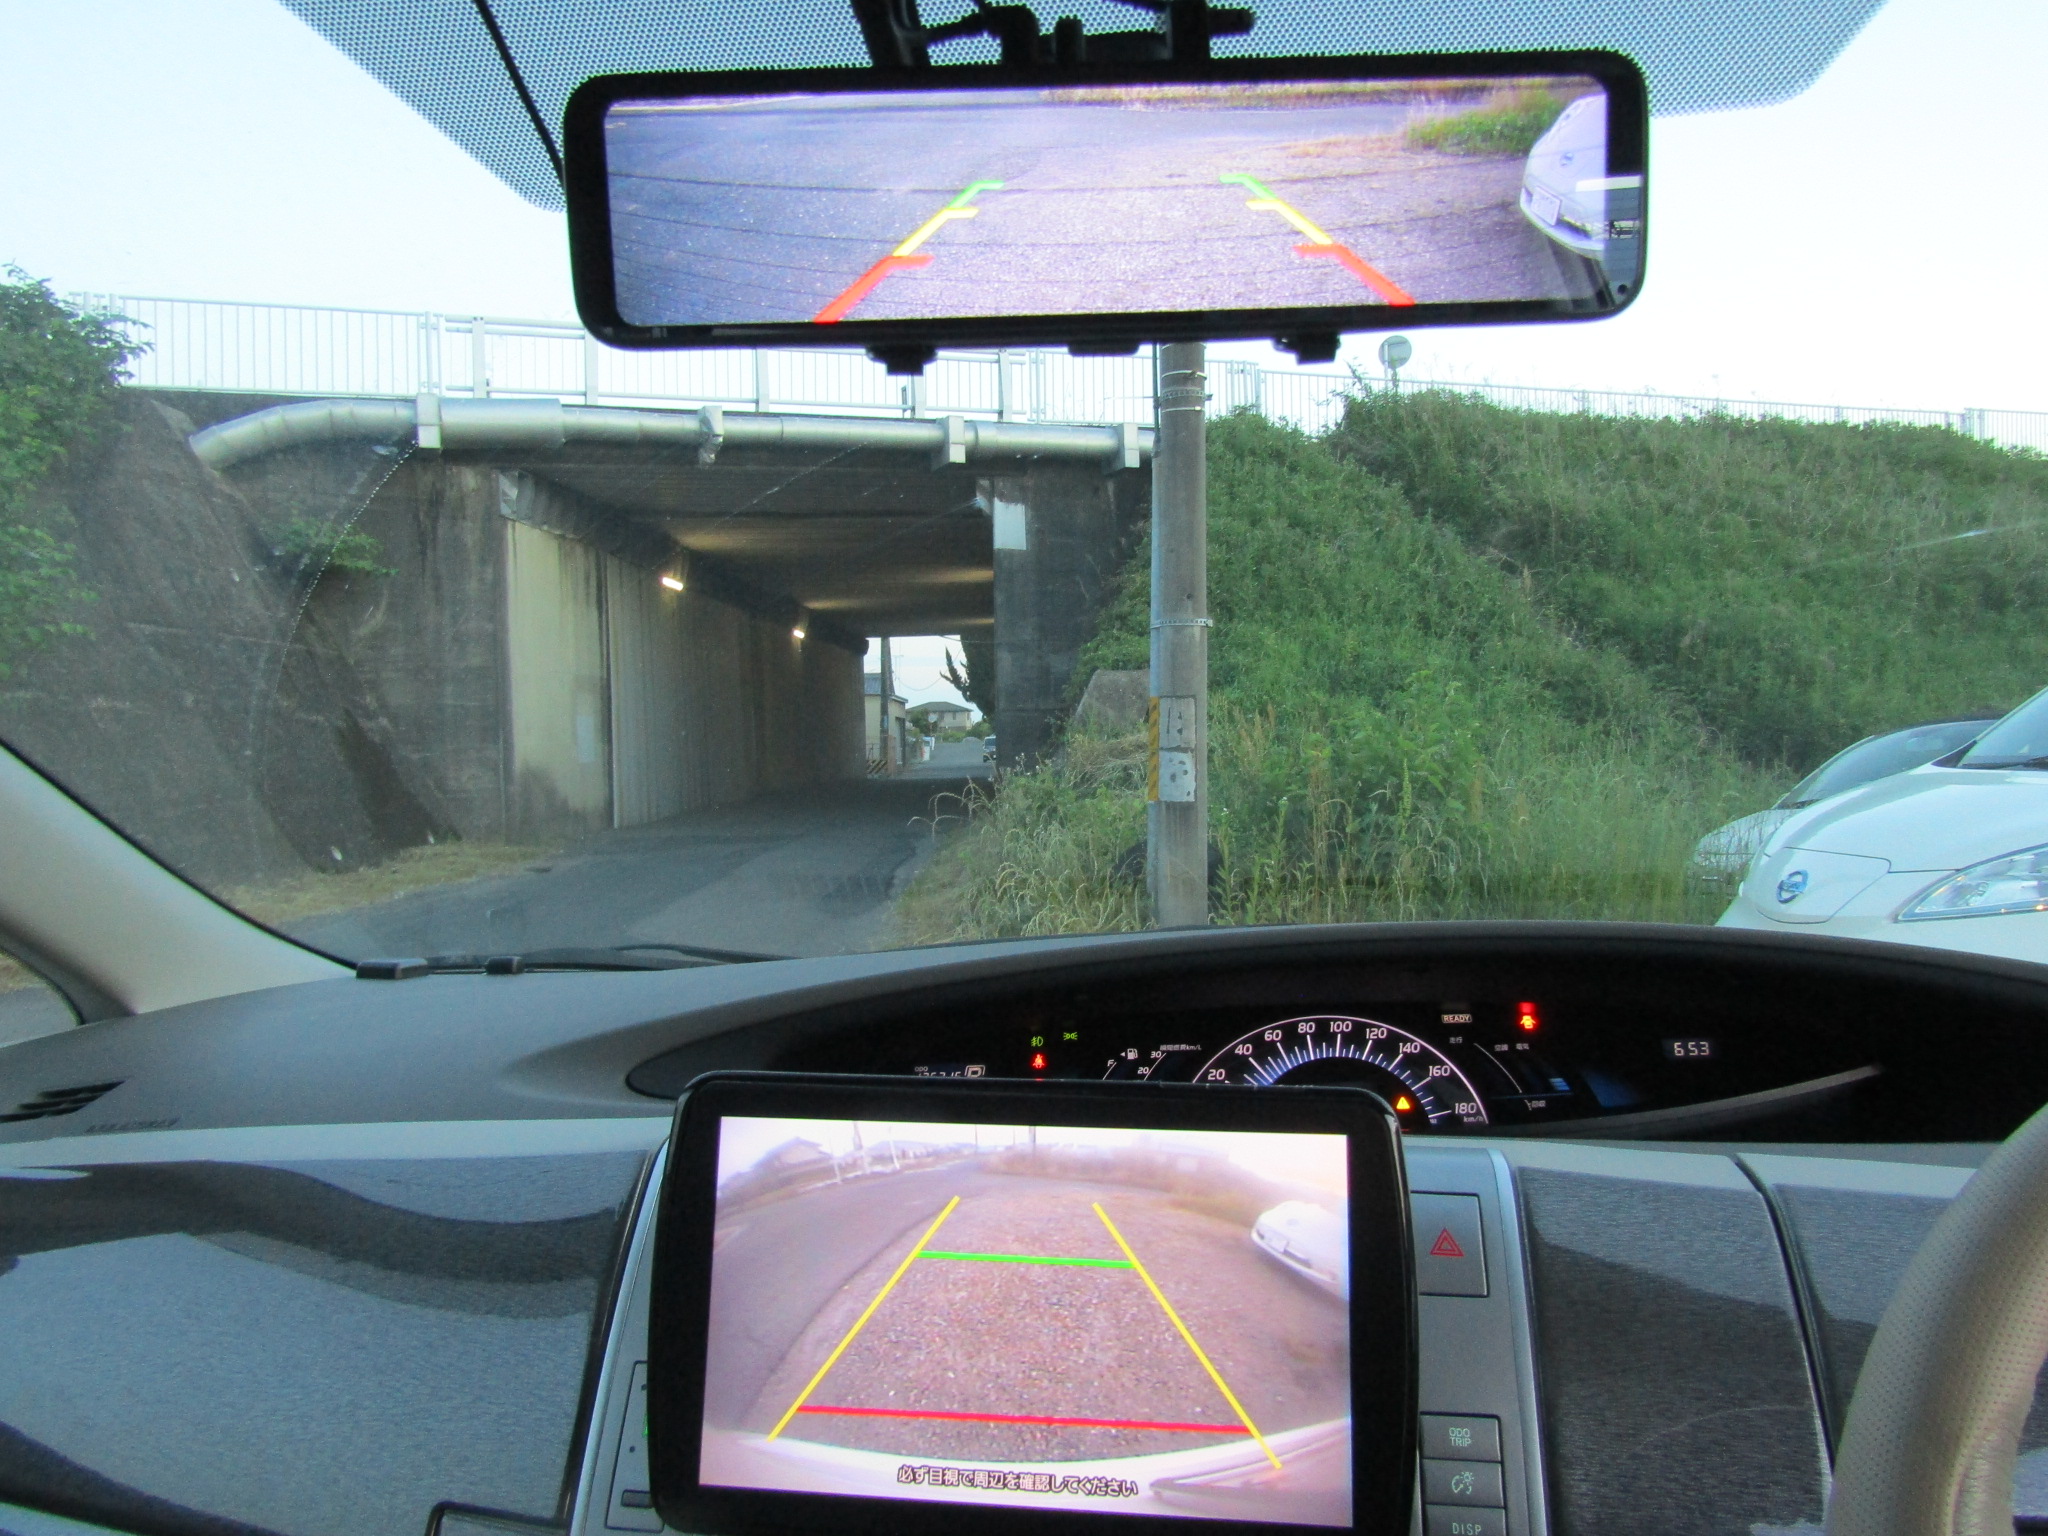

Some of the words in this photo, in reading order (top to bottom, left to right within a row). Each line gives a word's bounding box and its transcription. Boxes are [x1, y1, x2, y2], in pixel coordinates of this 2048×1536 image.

[1442, 1014, 1472, 1024] READY
[1297, 1022, 1316, 1034] 80
[1329, 1021, 1352, 1033] 100
[1264, 1030, 1282, 1042] 60
[1366, 1028, 1388, 1040] 120
[1235, 1043, 1253, 1056] 40
[1399, 1042, 1421, 1054] 140
[1150, 1051, 1162, 1059] 30
[1107, 1059, 1115, 1067] F
[1137, 1067, 1149, 1075] 20
[1207, 1069, 1226, 1081] 20
[1428, 1065, 1451, 1077] 160
[1454, 1103, 1477, 1114] 180
[1449, 1428, 1470, 1437] ODO
[1450, 1437, 1472, 1447] TRIP
[897, 1464, 1139, 1497] 必ず目視で周辺を確認してください
[1452, 1523, 1482, 1535] DISP
